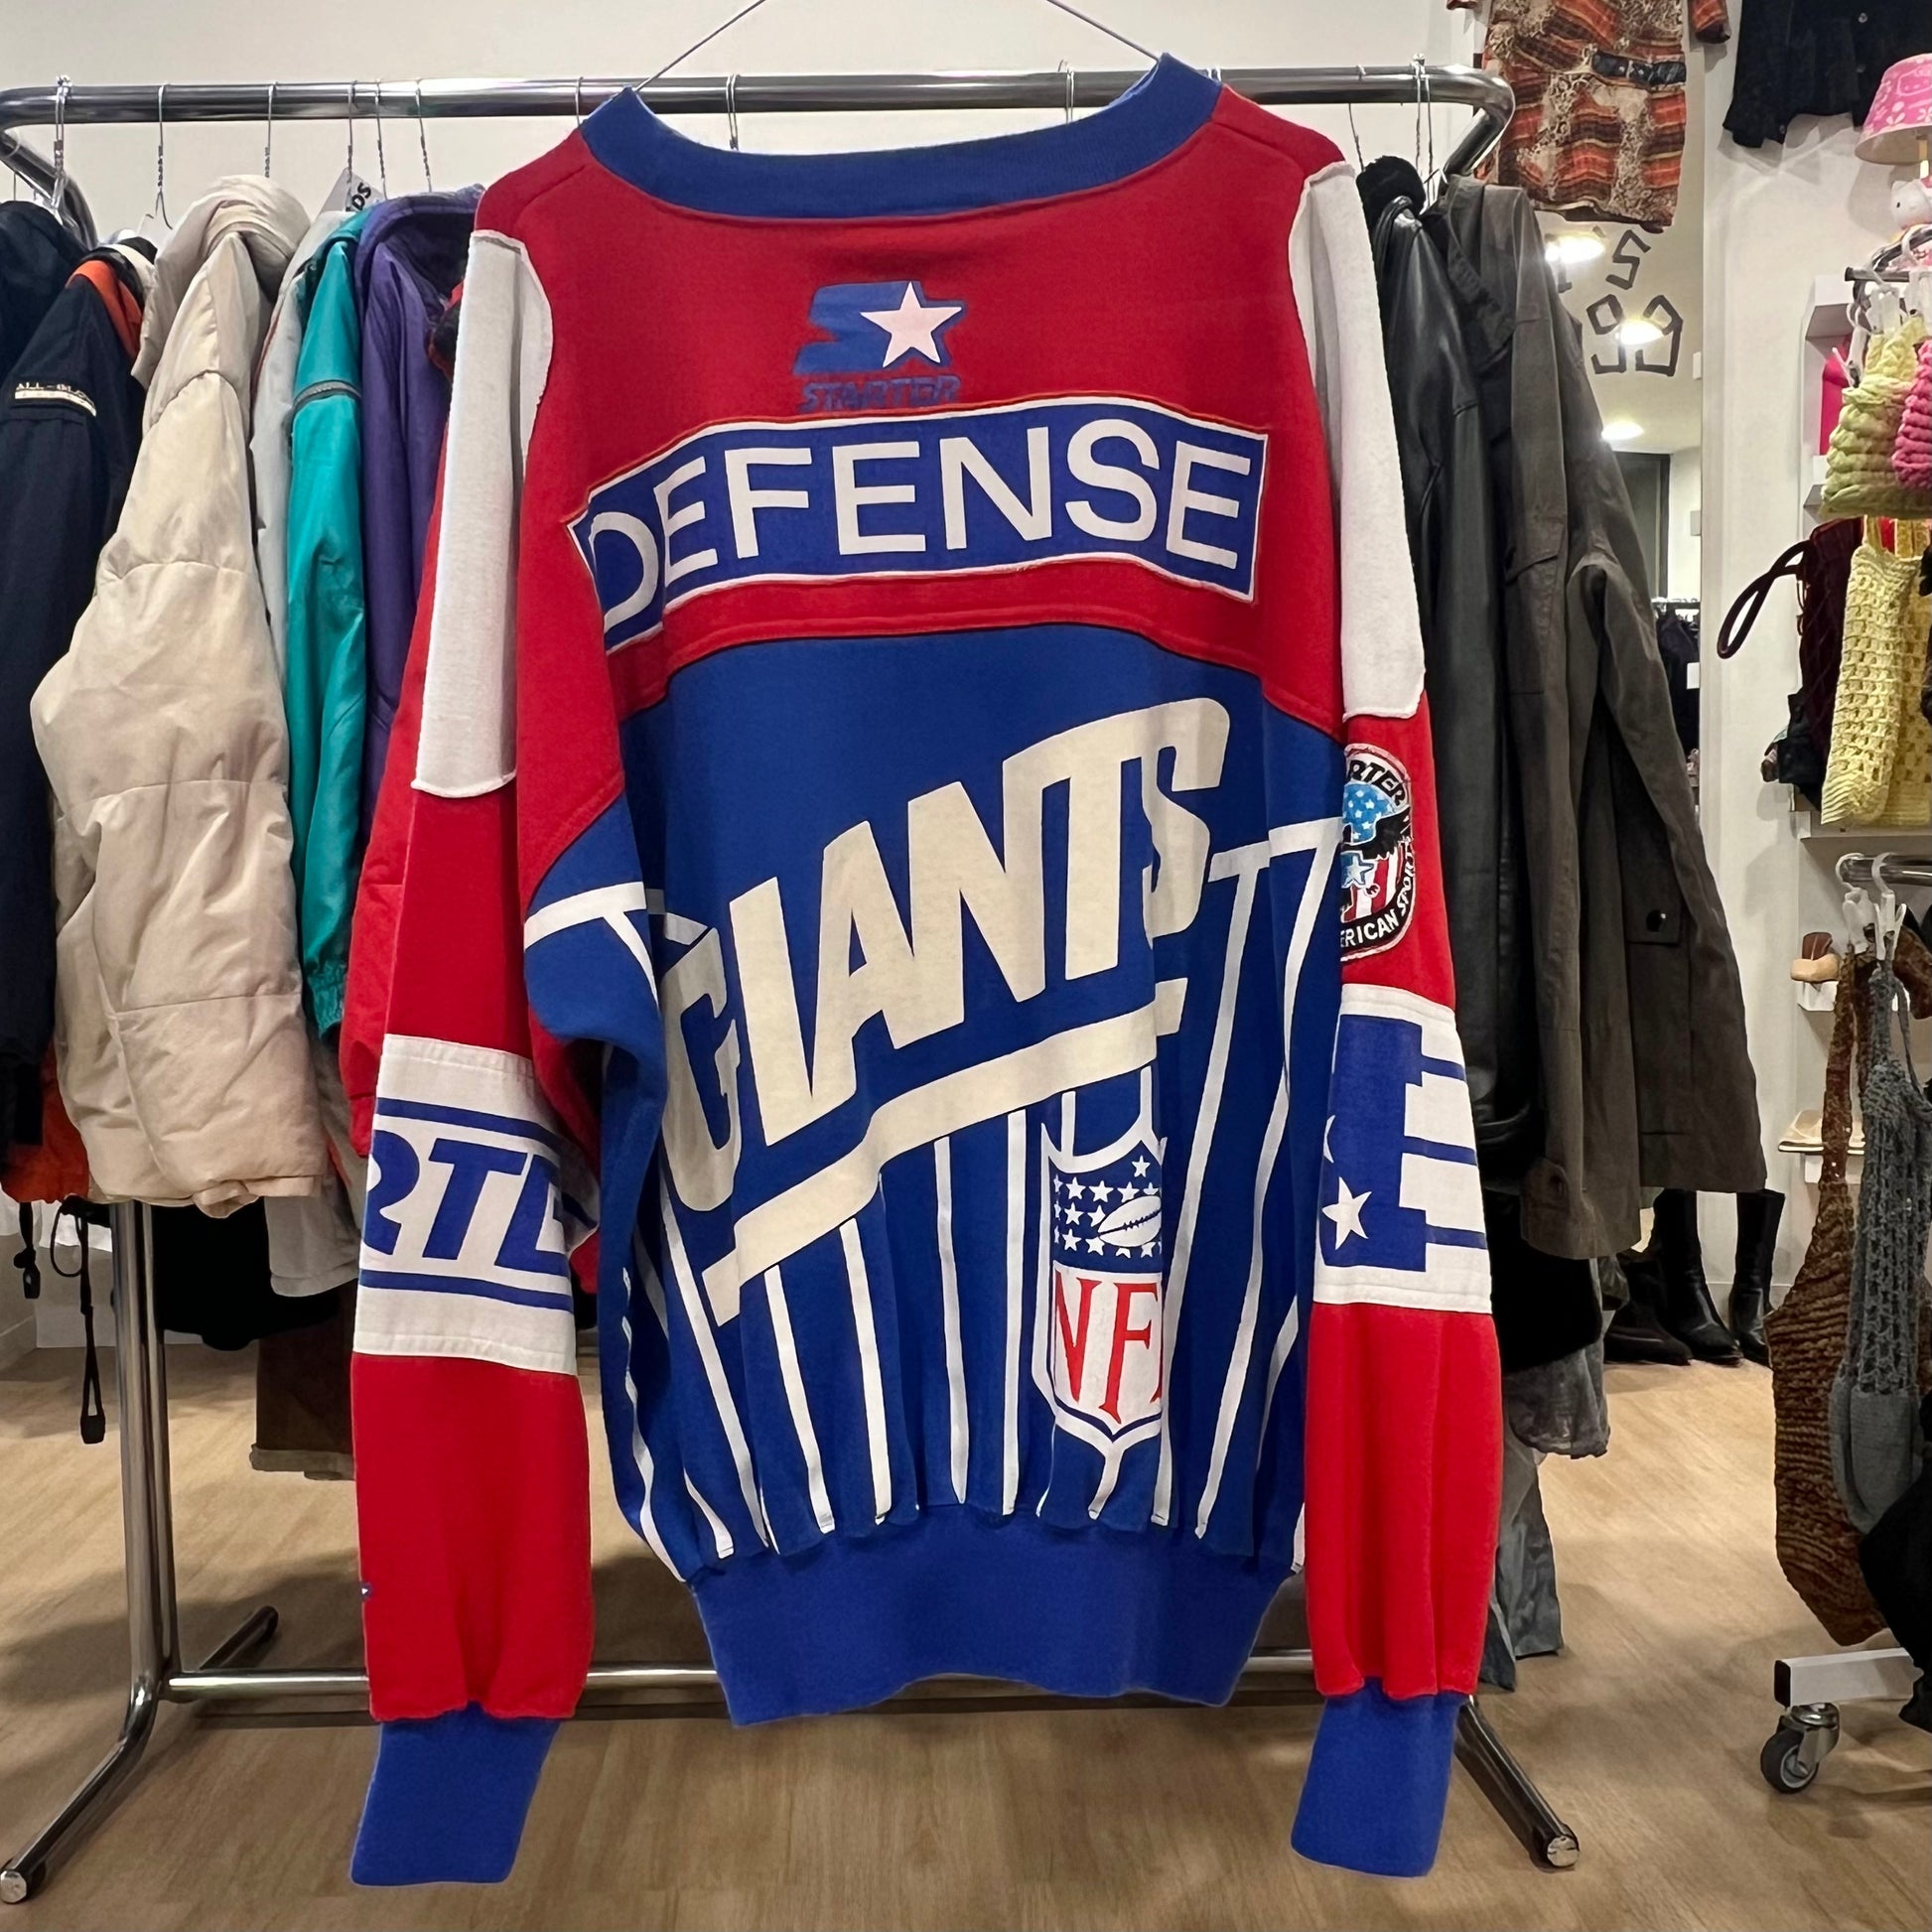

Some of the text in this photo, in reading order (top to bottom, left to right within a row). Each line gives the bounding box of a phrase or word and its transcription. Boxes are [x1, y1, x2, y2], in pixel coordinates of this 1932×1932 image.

[590, 418, 1251, 634] DEFENSE
[660, 697, 1230, 1210] GIANTS
[1055, 1270, 1163, 1425] NF
